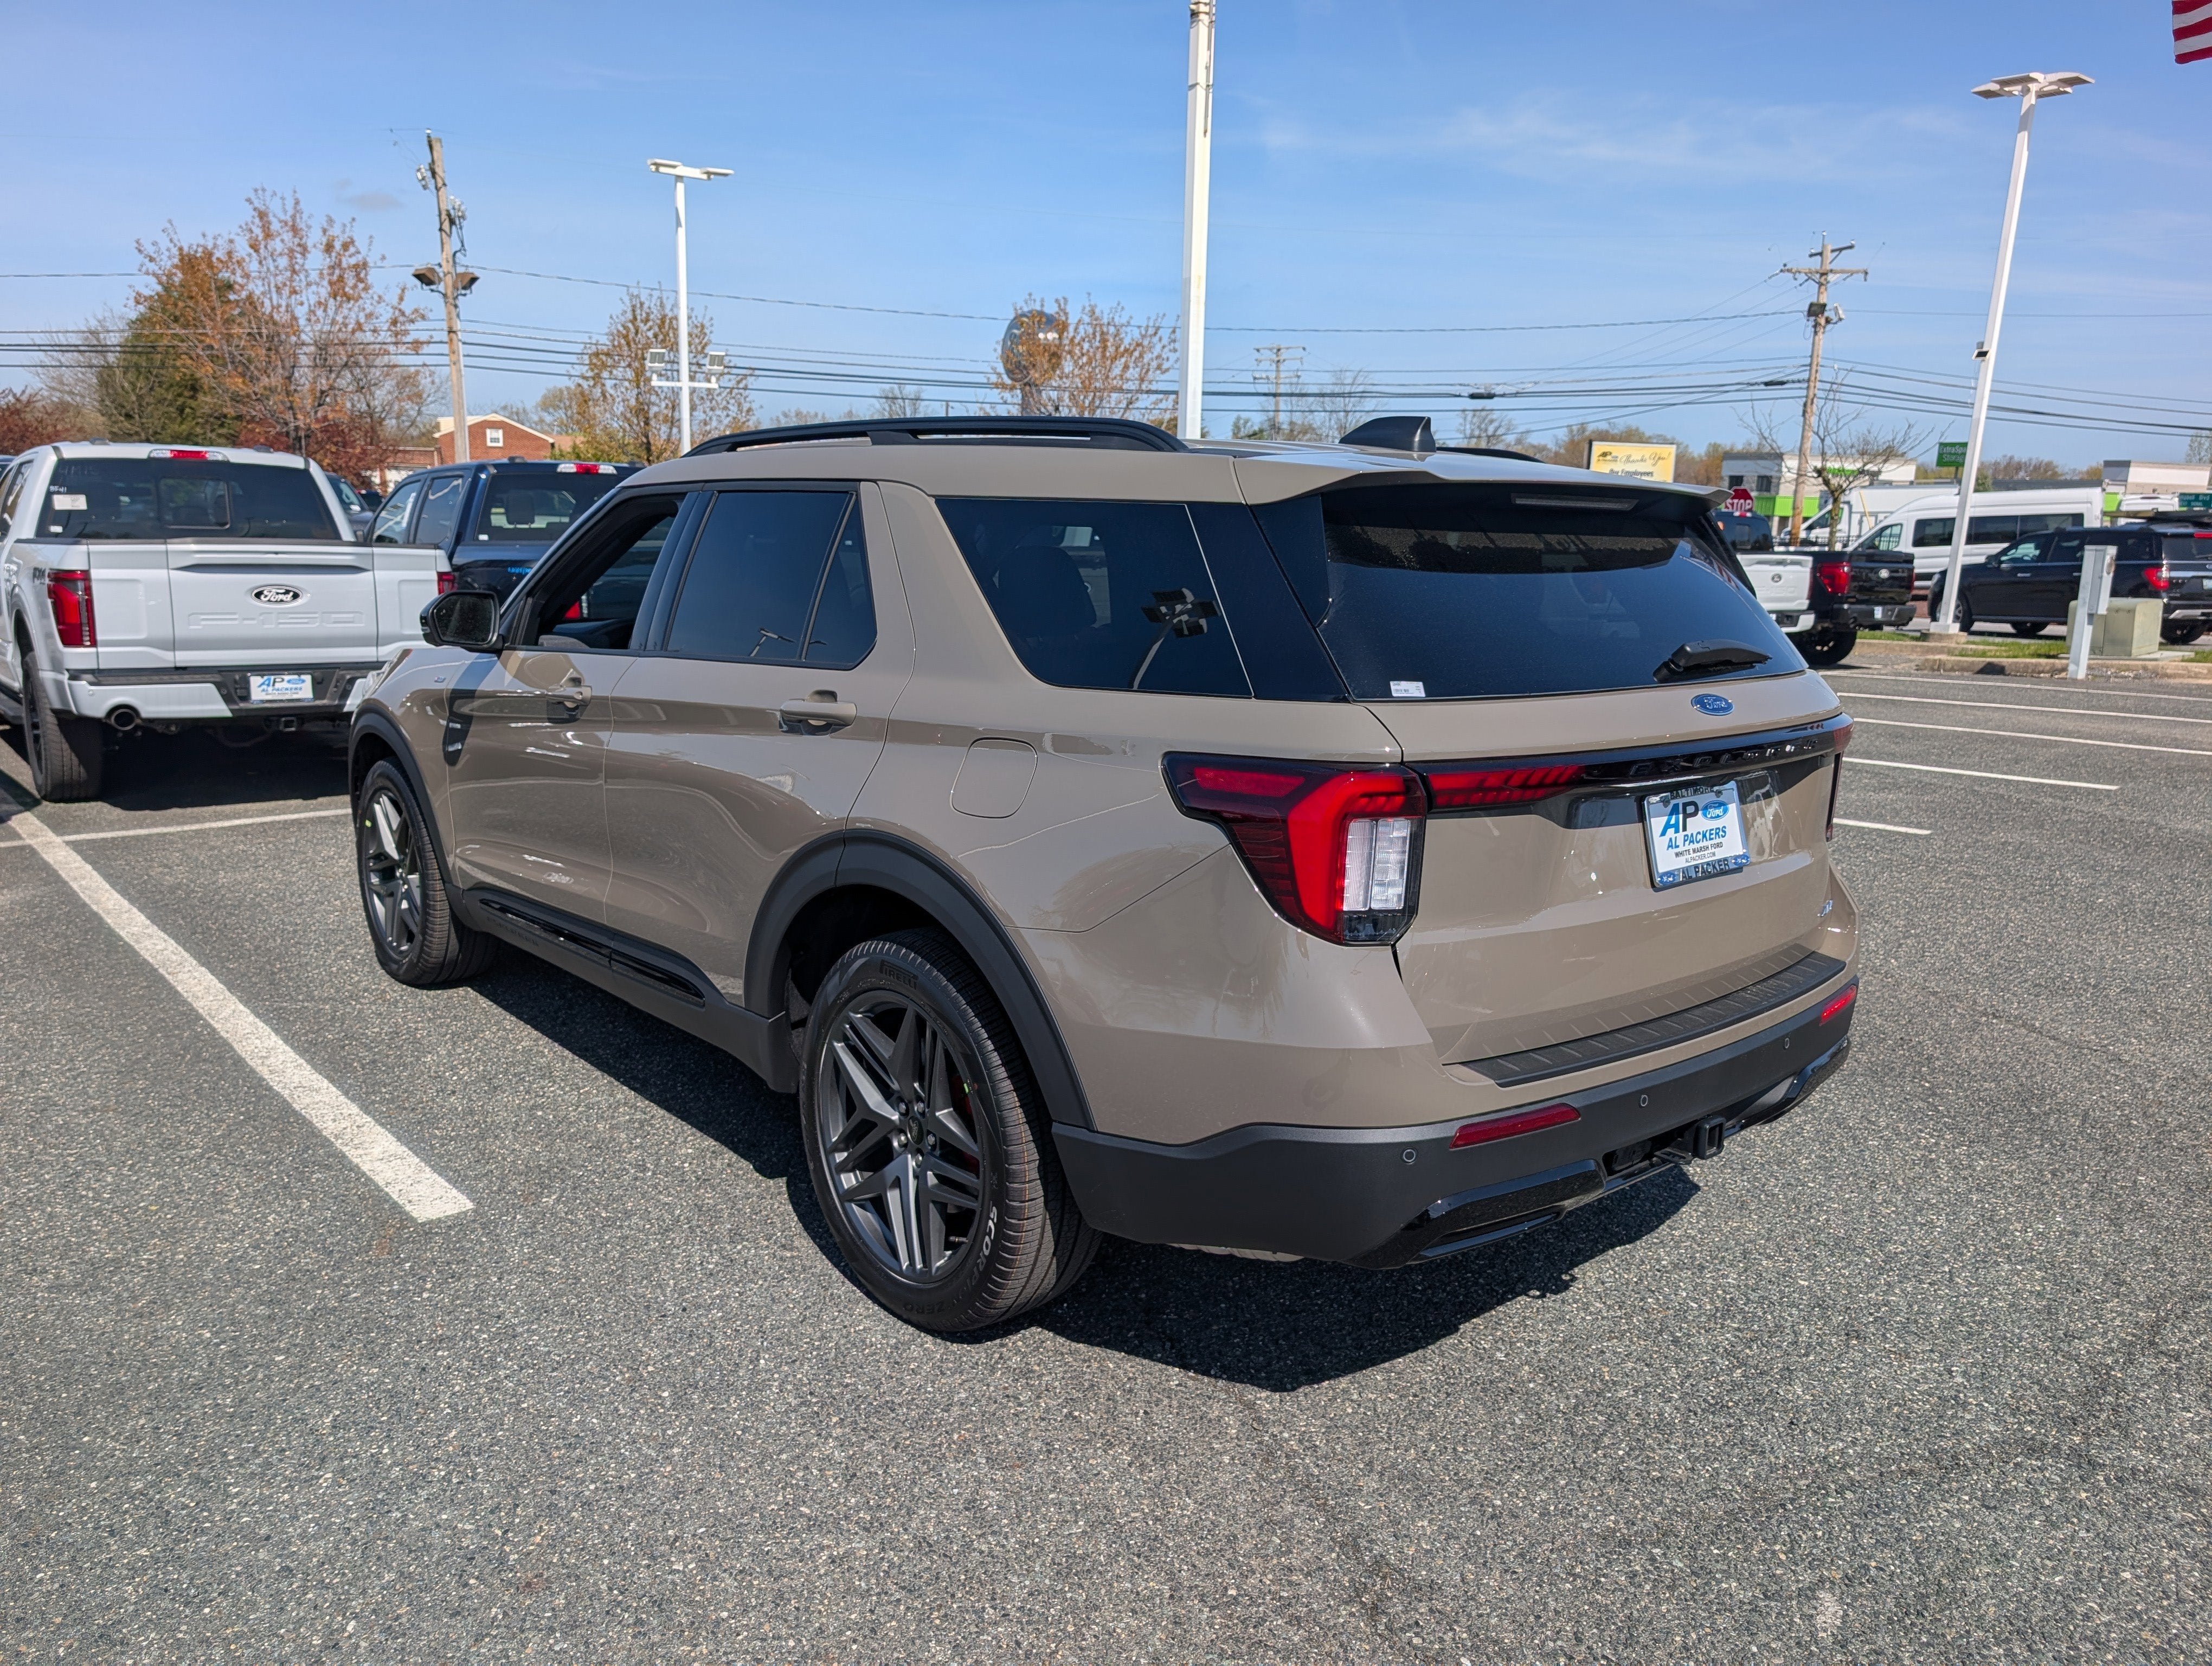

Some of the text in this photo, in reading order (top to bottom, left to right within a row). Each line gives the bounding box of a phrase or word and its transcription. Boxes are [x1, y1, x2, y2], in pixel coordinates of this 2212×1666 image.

[1939, 445, 1967, 454] ExtraSpa
[1943, 453, 1965, 464] Storag
[1621, 469, 1654, 479] Employees
[1726, 499, 1752, 512] STOP
[261, 588, 294, 601] Ford
[188, 611, 365, 629] F-150
[257, 676, 285, 688] AP
[1670, 786, 1715, 800] BALTIMORE
[1659, 800, 1700, 838] AP
[1666, 825, 1727, 851] AL PACKERS
[1674, 841, 1724, 858] WHITE MARSH FORD
[1685, 851, 1716, 863] ALPACKER.COM
[1681, 869, 1693, 880] AL
[1695, 858, 1730, 877] PACKER
[879, 959, 919, 990] PIRELLI
